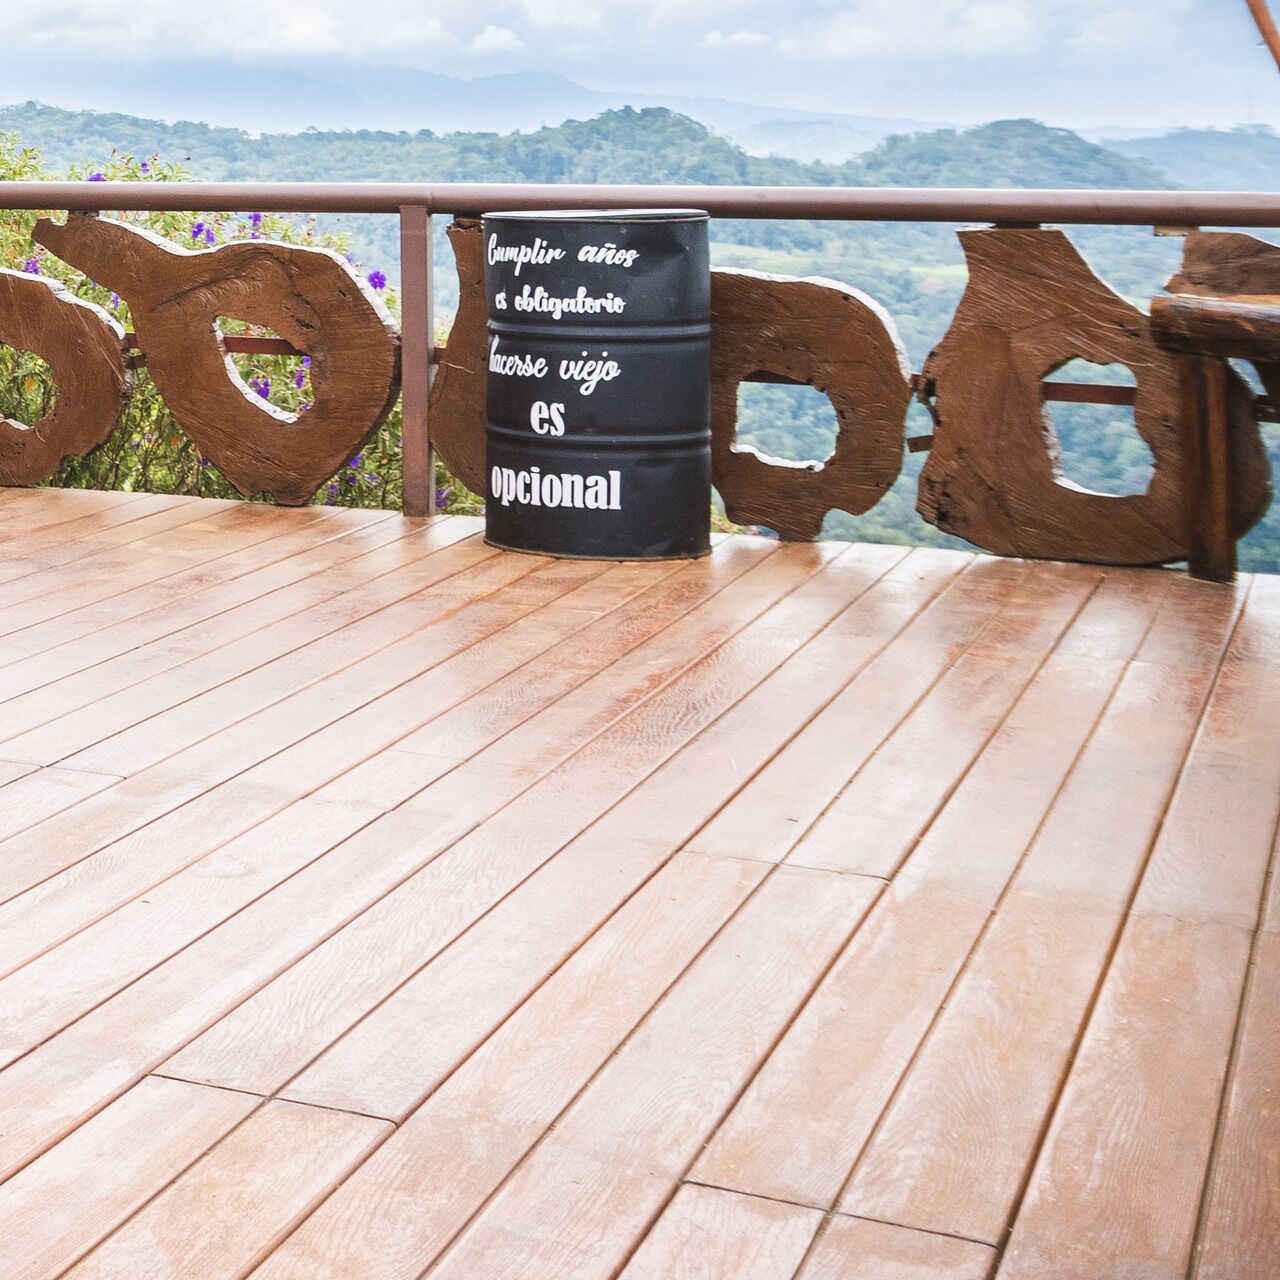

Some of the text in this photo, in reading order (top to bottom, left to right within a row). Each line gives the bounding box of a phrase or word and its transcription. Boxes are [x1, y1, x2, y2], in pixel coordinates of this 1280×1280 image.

[488, 233, 640, 276] Cumplir años
[514, 285, 626, 320] obligatorio
[488, 335, 621, 395] hacerse viejo
[530, 401, 565, 436] es
[492, 466, 621, 510] opcional
